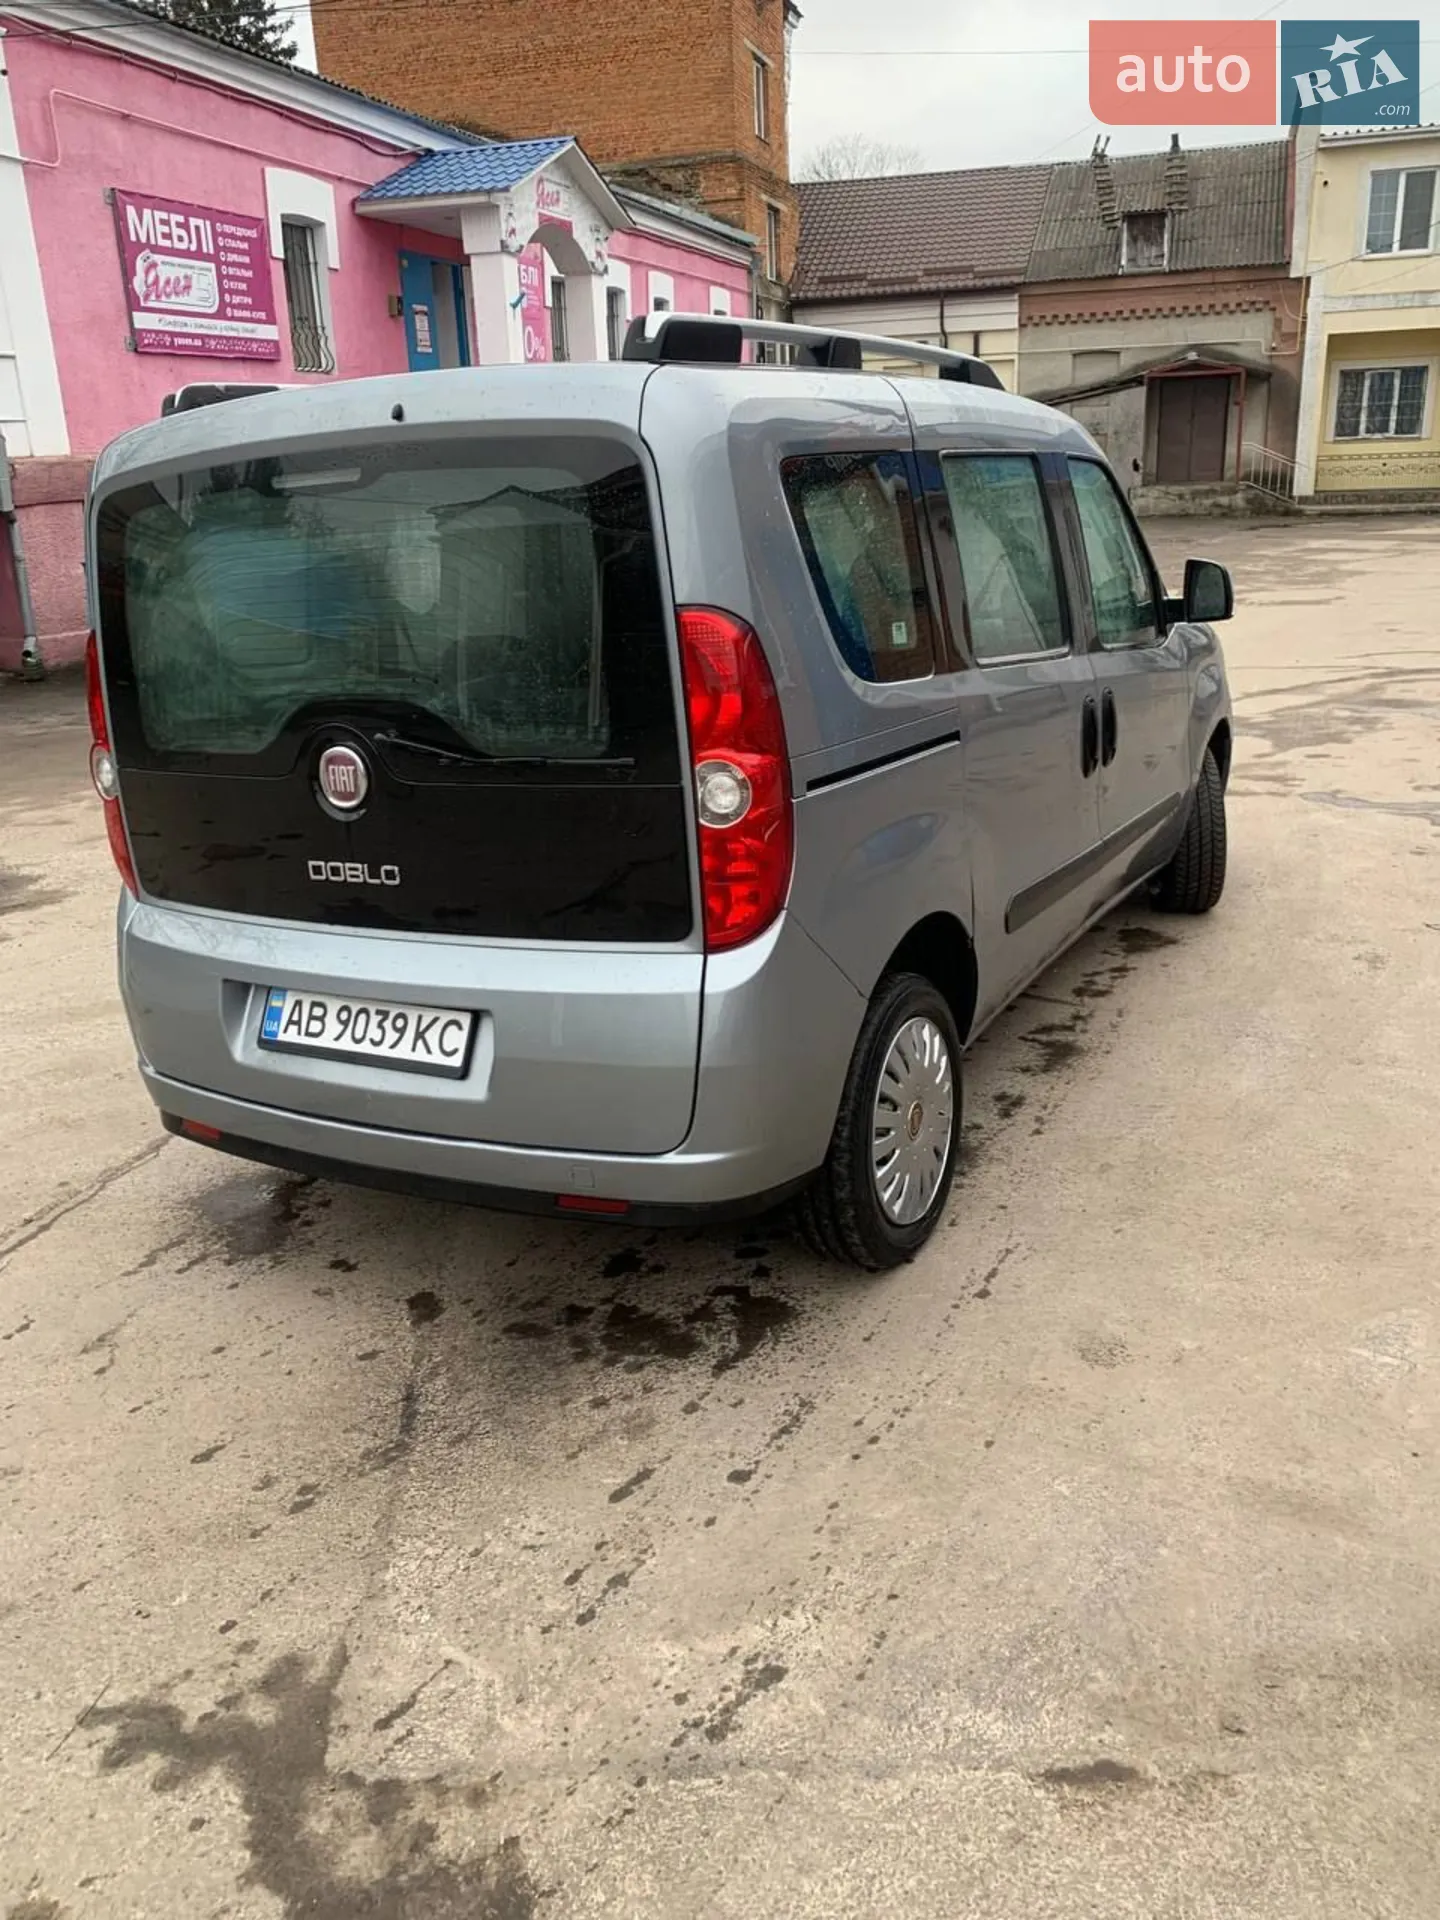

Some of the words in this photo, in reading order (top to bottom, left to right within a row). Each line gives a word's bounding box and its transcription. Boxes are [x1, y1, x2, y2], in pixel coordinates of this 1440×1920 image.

[126, 204, 215, 255] МЕБЛІ
[519, 263, 539, 287] БЛІ
[328, 764, 355, 793] FIAT
[308, 860, 400, 885] DOBLO
[265, 1019, 279, 1032] UA
[283, 999, 328, 1038] AB
[333, 1004, 409, 1050] 9039
[411, 1014, 464, 1058] KC
